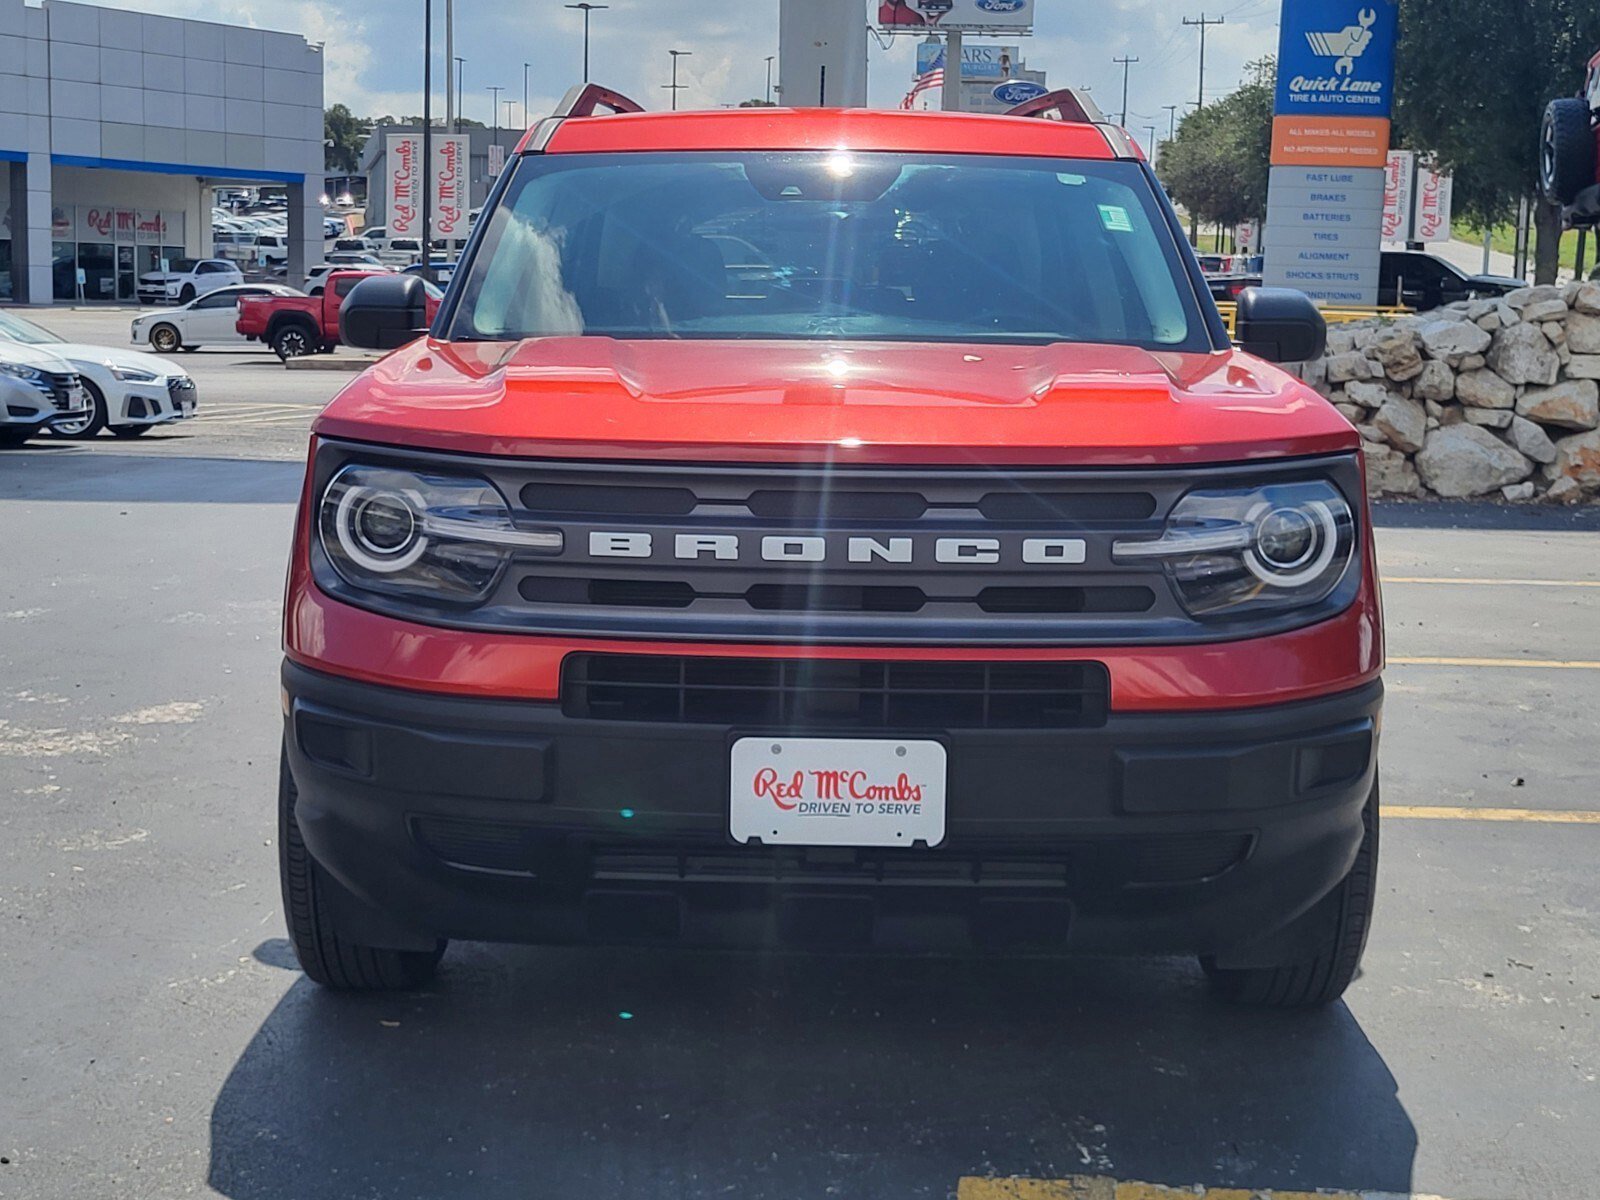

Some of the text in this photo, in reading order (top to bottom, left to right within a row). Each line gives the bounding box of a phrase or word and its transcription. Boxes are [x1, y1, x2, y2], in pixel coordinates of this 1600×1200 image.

[1289, 75, 1382, 92] Quick Lane
[1289, 93, 1381, 104] TIRE & AUTO CENTER
[412, 165, 418, 177] TO
[457, 165, 463, 176] TO
[1306, 173, 1354, 183] FAST LUBE
[392, 140, 416, 232] Red McCombs
[437, 141, 461, 233] Red McCombs
[1310, 193, 1347, 202] BRAKES
[88, 208, 113, 235] Red
[1302, 212, 1352, 222] BATTERIES
[1382, 212, 1402, 236] Red
[1421, 213, 1442, 237] Red
[1313, 232, 1339, 241] TIRES
[1298, 252, 1350, 261] ALIGNMENT
[589, 531, 1087, 565] BRONCO
[754, 767, 923, 811] Red McCombs
[798, 802, 922, 815] DRIVEN TO SERVE
